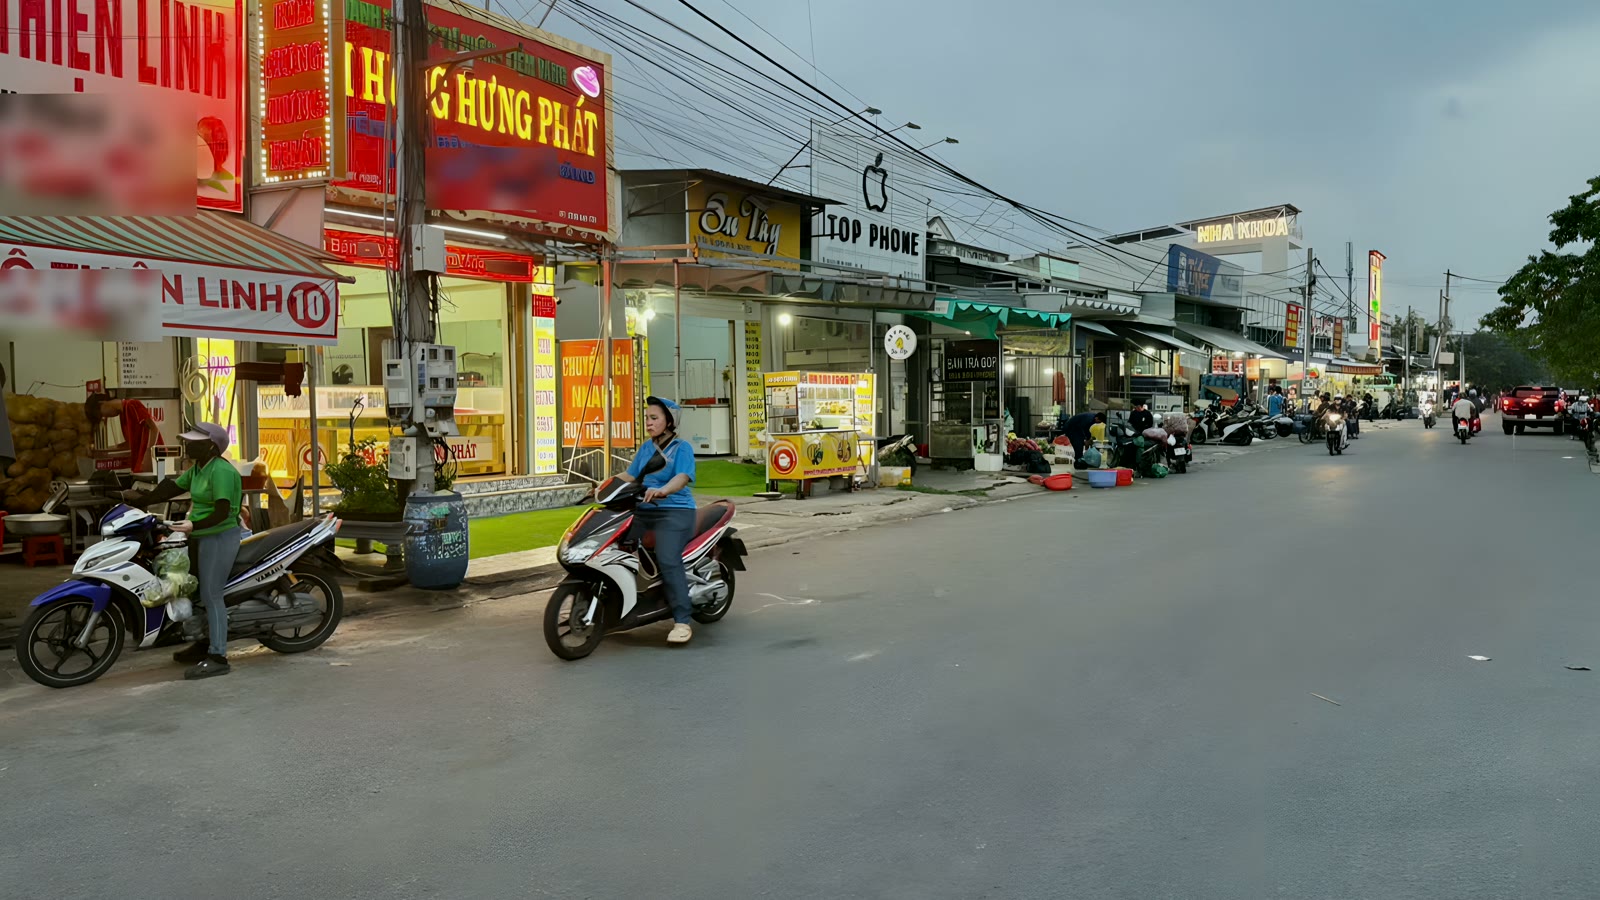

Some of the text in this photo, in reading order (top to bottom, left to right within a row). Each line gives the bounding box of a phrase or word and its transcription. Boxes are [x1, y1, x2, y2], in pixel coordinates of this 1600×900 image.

[137, 0, 227, 100] LINH
[456, 74, 533, 141] HƯNG
[537, 94, 599, 157] PHÁT
[827, 214, 862, 244] TOP
[869, 223, 920, 257] PHONE
[1237, 216, 1289, 239] KHOA
[197, 276, 283, 314] LINH
[292, 289, 326, 323] 10
[571, 385, 621, 408] NHAH
[451, 439, 477, 460] PHÁT
